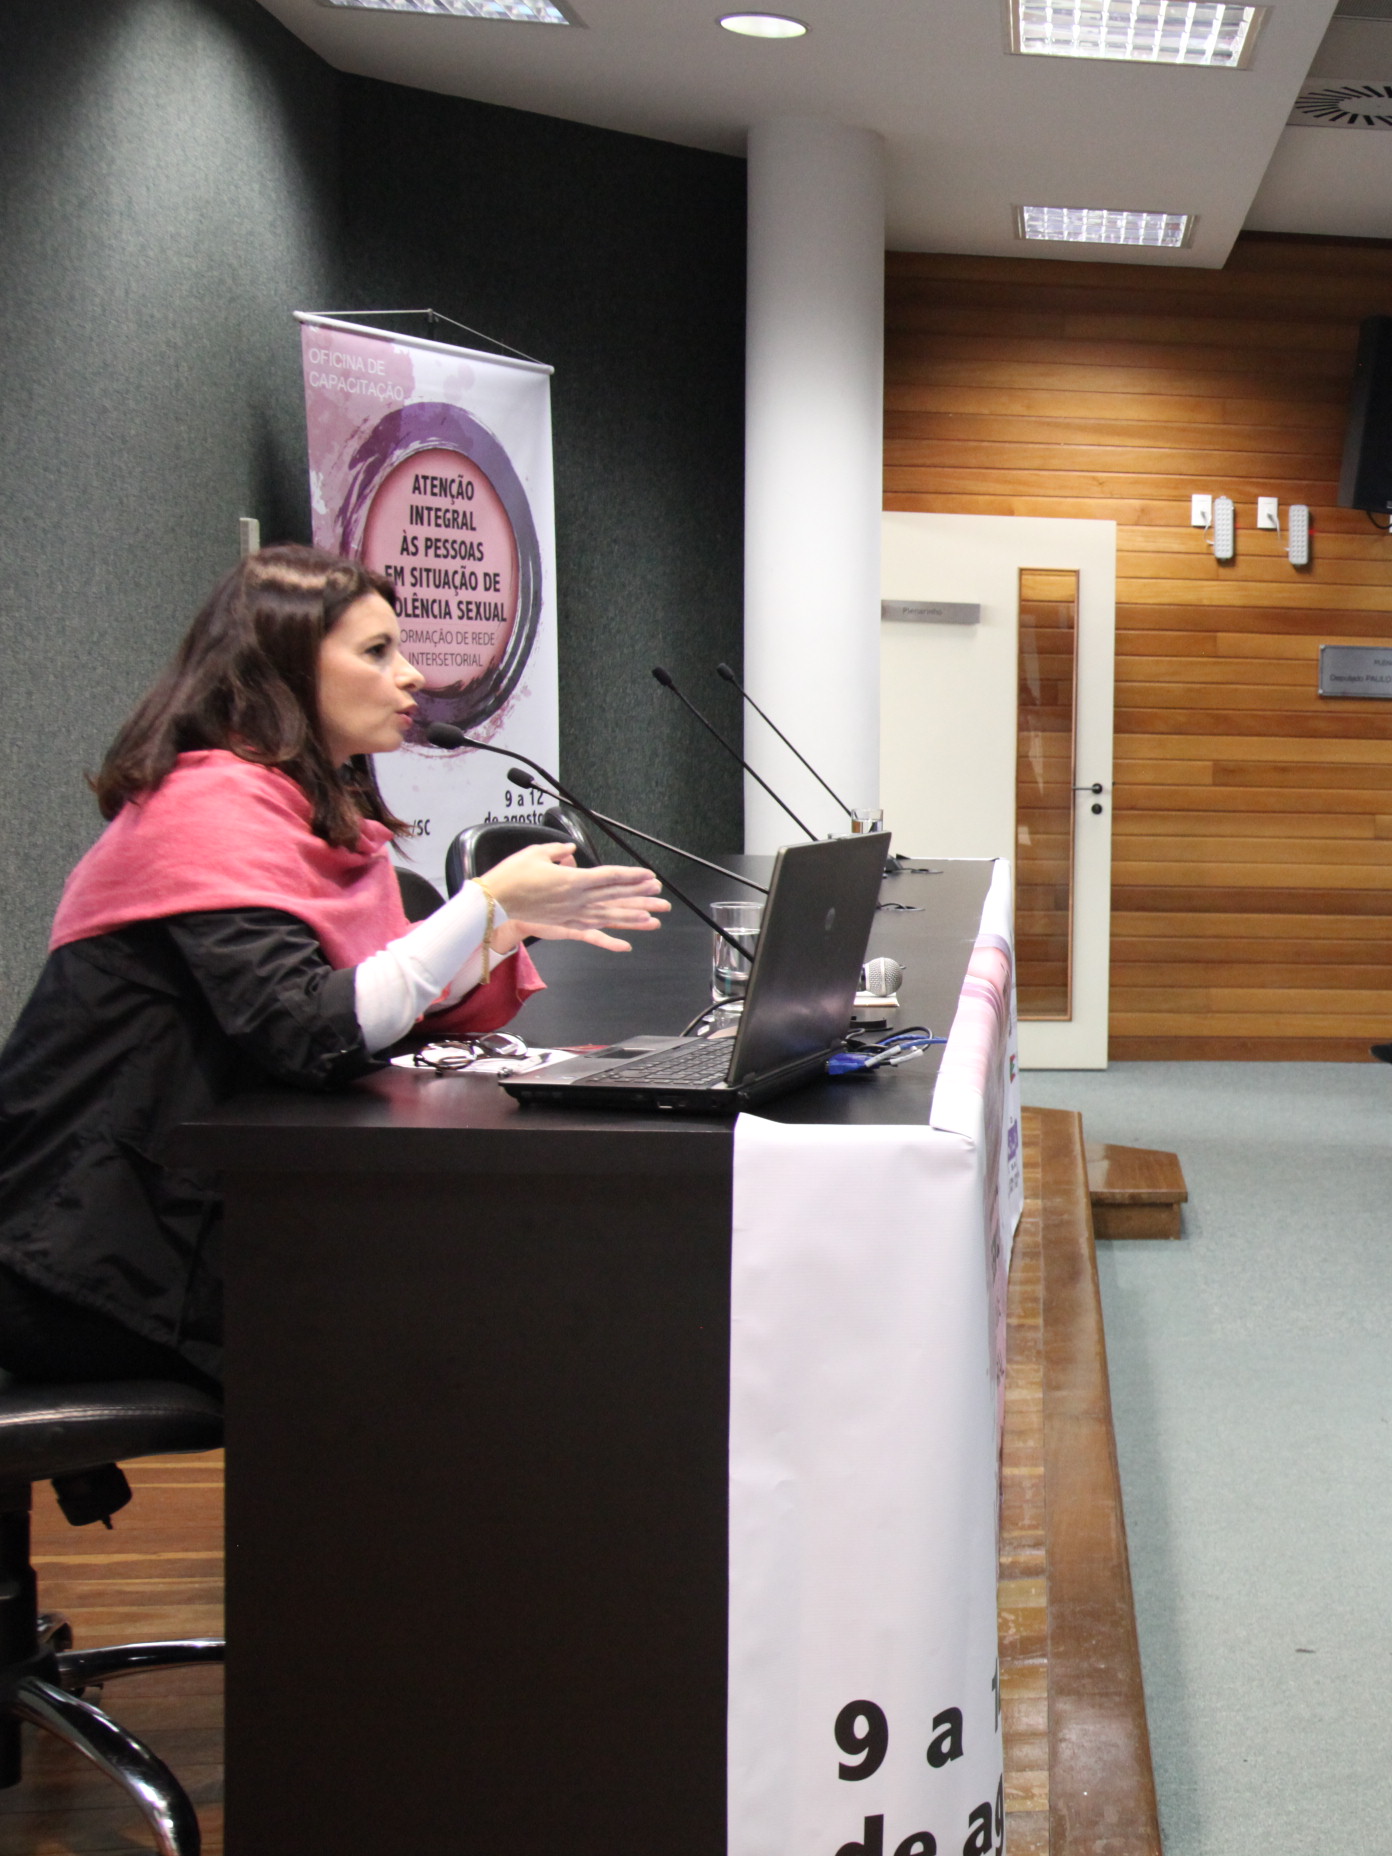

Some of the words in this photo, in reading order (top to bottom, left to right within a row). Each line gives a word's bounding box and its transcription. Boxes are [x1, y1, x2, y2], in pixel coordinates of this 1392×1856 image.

[309, 347, 365, 372] OFICINA
[367, 357, 386, 376] DE
[309, 370, 404, 402] CAPACITAÇÃO
[412, 474, 475, 505] ATENÇÃO
[410, 504, 477, 531] INTEGRAL
[400, 529, 419, 556] ÀS
[424, 537, 484, 562] PESSOAS
[384, 565, 405, 587] EM
[410, 564, 478, 597] SITUAÇÃO
[483, 571, 501, 593] DE
[395, 592, 453, 620] OLÊNCIA
[457, 600, 507, 623] SEXUAL
[400, 628, 453, 648] ORMAÇÃO
[456, 631, 469, 645] DE
[472, 632, 495, 646] REDE
[408, 652, 484, 667] INTERSETORIAL
[1329, 674, 1364, 683] Deputado
[1365, 675, 1391, 684] PAULO
[505, 790, 513, 807] 9
[517, 793, 524, 807] a
[529, 788, 544, 806] 12
[834, 1699, 889, 1782] 9
[926, 1706, 964, 1769] a
